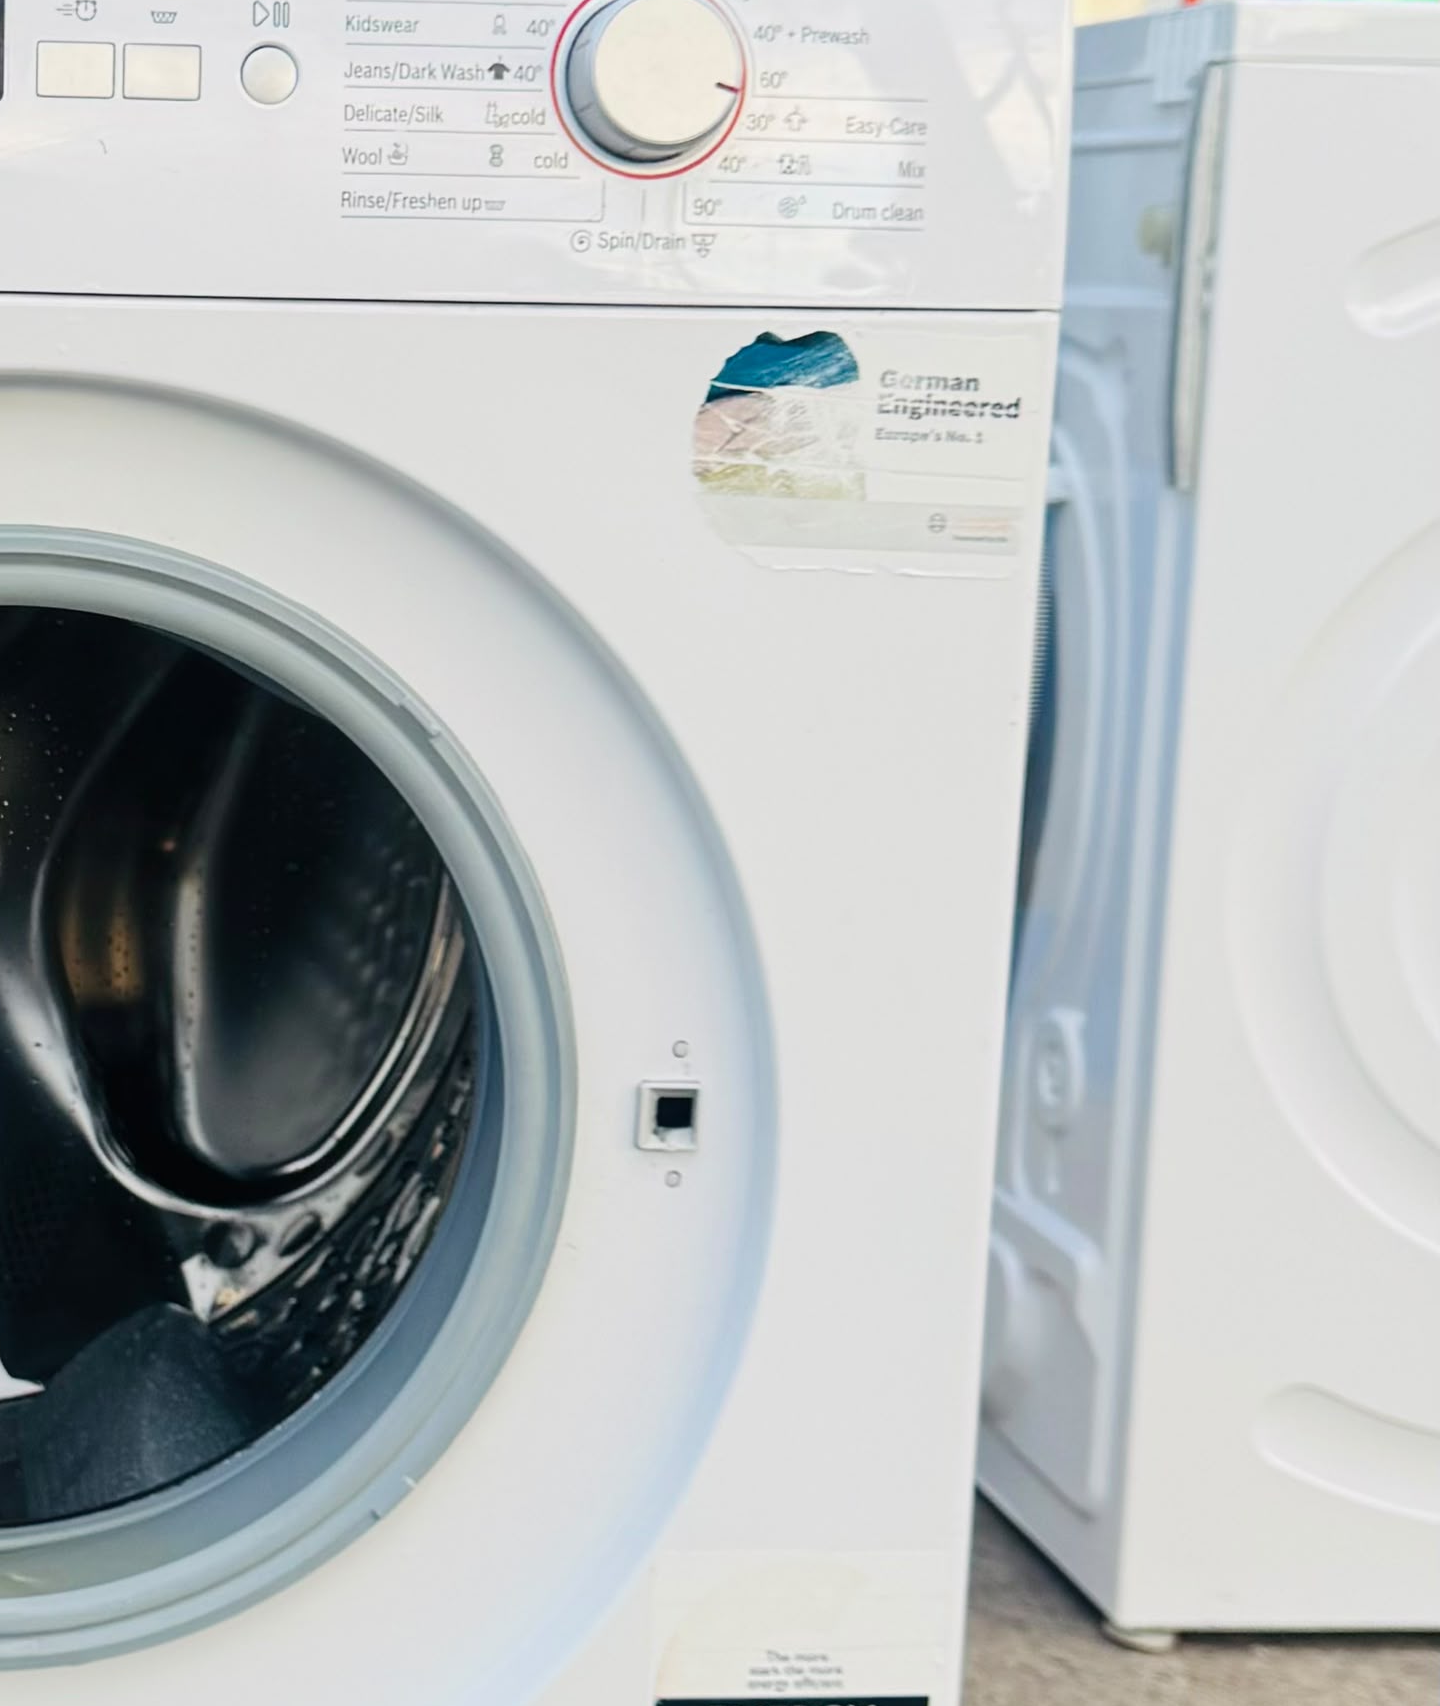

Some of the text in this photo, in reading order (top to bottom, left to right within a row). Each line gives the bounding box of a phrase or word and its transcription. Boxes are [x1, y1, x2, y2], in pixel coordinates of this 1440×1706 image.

[345, 15, 420, 34] Kidswear
[526, 19, 556, 36] 40°
[800, 26, 869, 44] Prewash
[344, 62, 485, 82] Jeans/Dark Wash
[513, 65, 543, 82] 40°
[344, 104, 444, 125] Delicate/Silk
[511, 109, 546, 126] cold
[846, 116, 927, 137] Easy-Care
[342, 147, 382, 165] Wool
[534, 152, 569, 169] cold
[341, 191, 482, 213] Rinse/Freshen up
[693, 198, 723, 216] 90°
[832, 202, 924, 221] Drum clean
[597, 231, 686, 251] Spin/Drain
[877, 393, 1021, 421] Engineered
